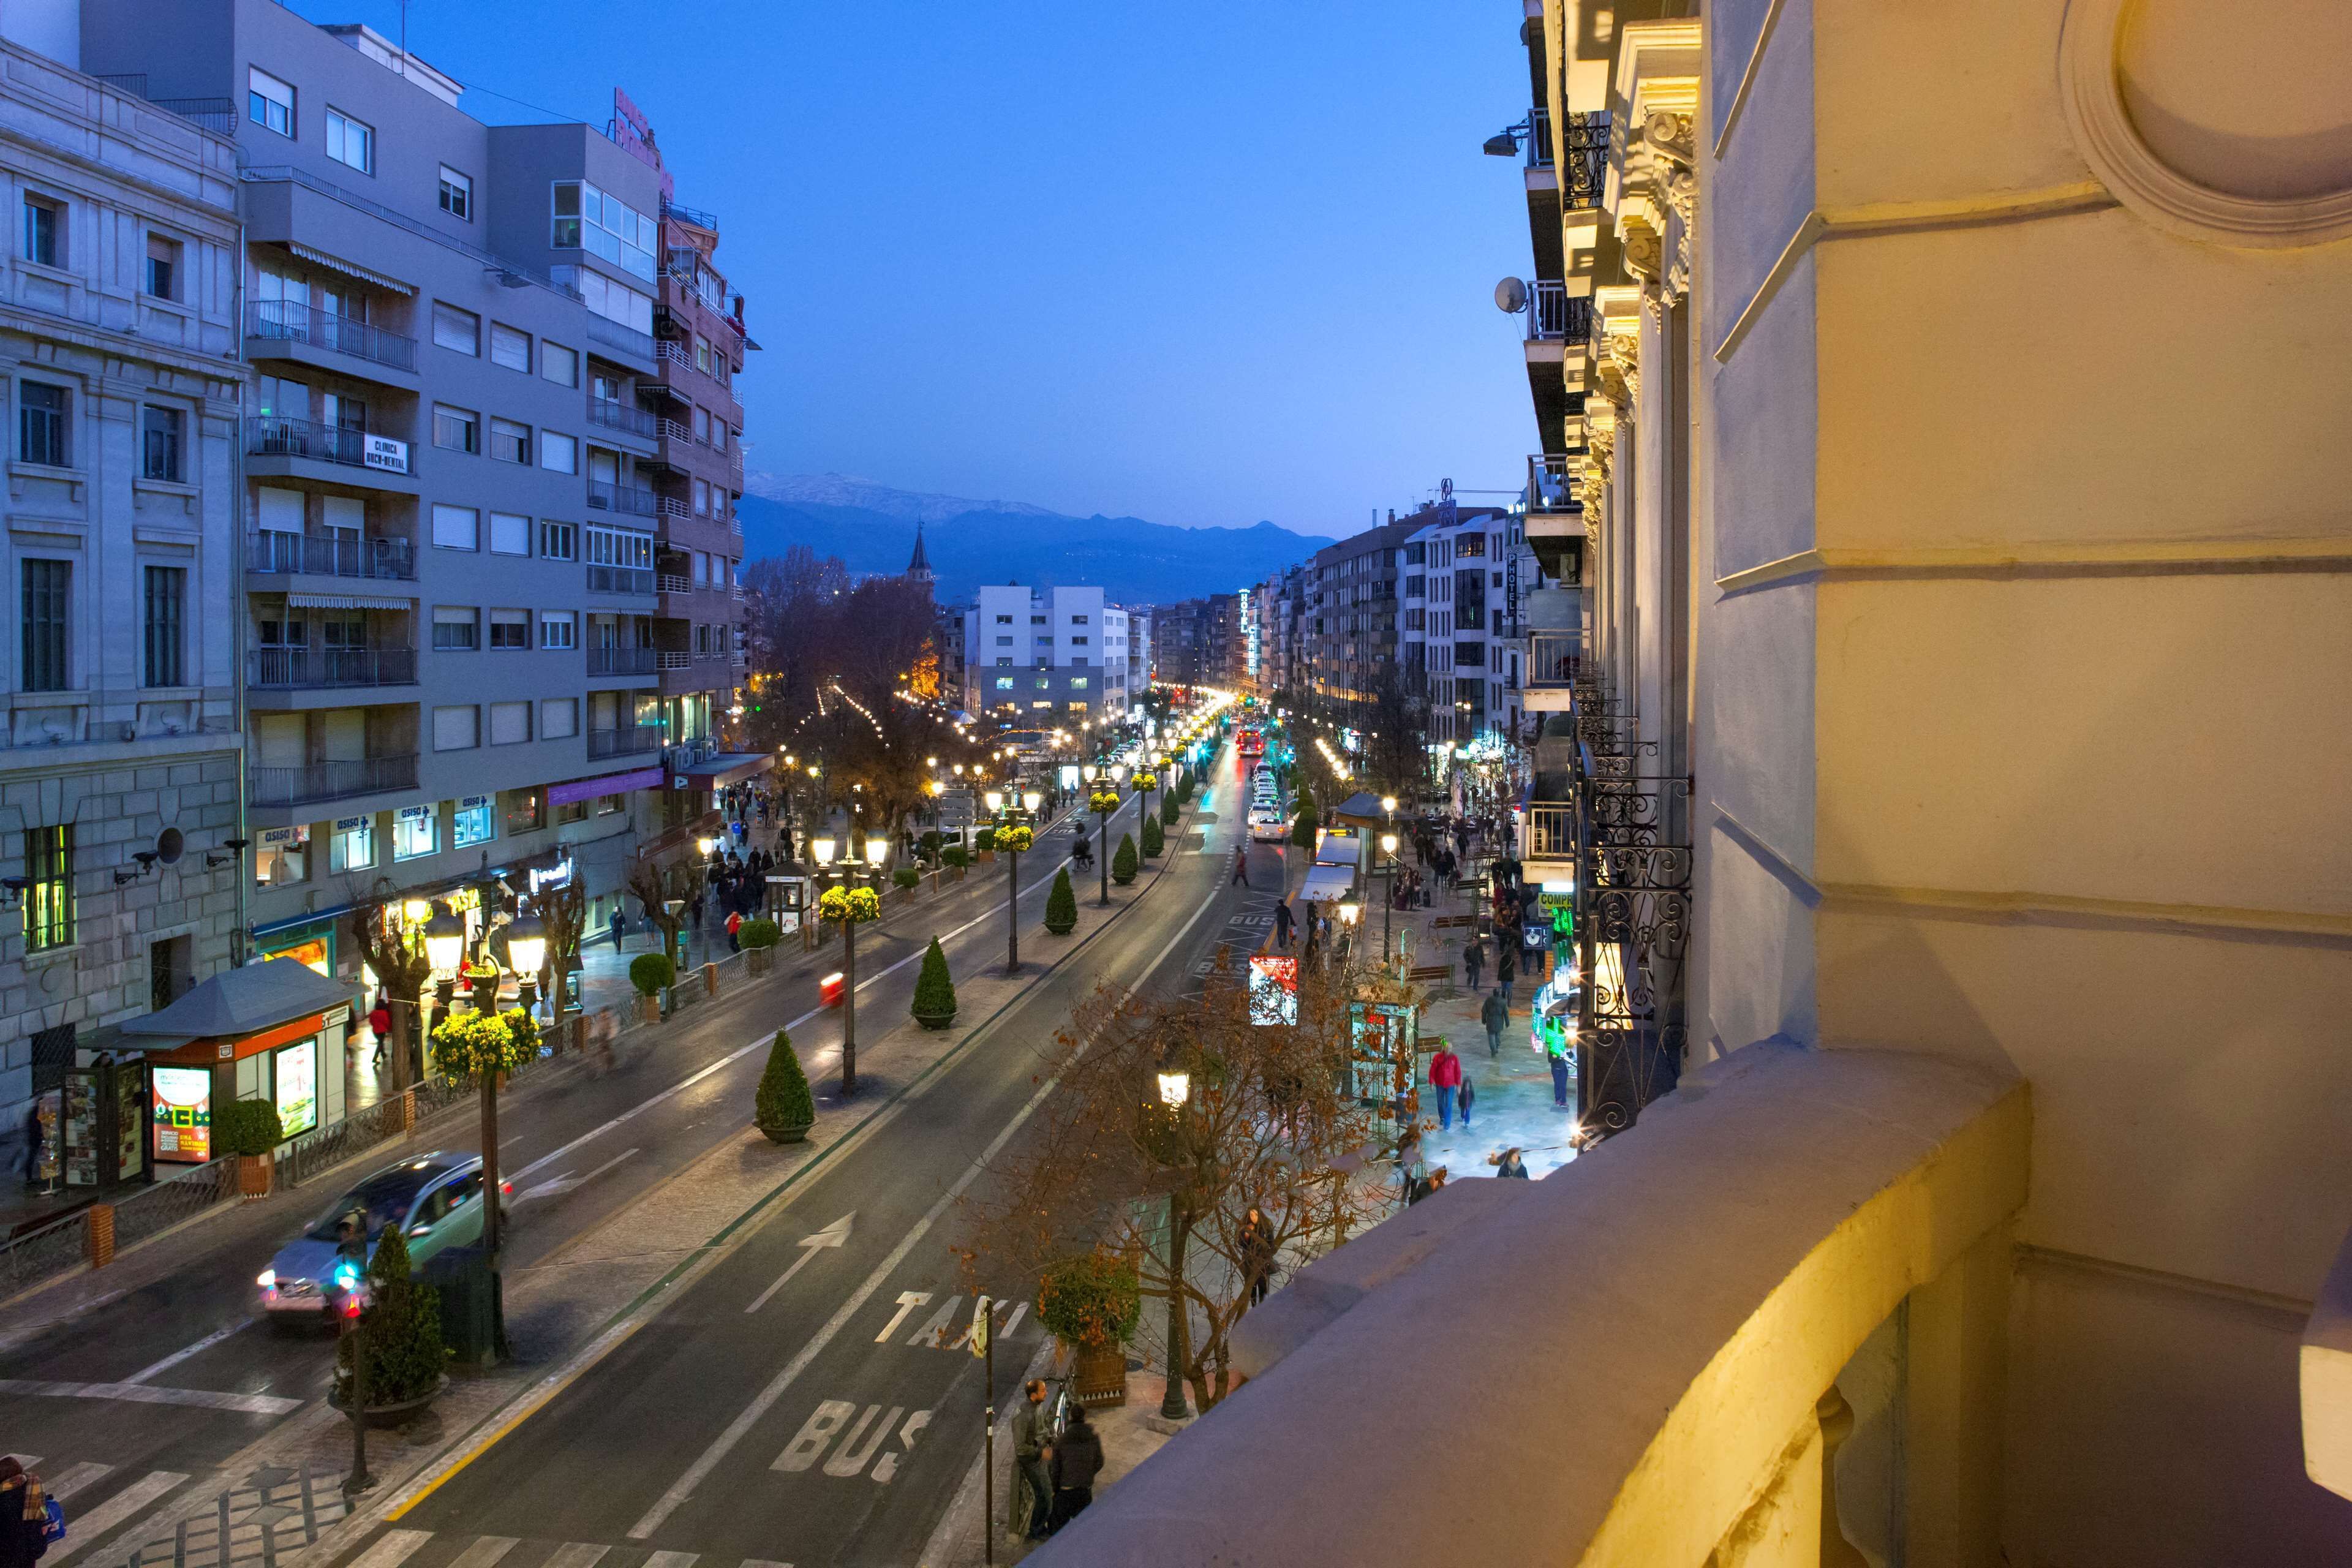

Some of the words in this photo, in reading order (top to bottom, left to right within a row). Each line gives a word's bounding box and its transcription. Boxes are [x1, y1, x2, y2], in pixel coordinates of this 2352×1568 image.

[375, 440, 398, 455] CLINICA
[463, 797, 480, 807] asisa
[402, 807, 421, 818] asisa
[337, 818, 359, 830] asisa
[265, 828, 290, 842] asisa
[1229, 916, 1275, 925] BUS
[769, 1400, 935, 1484] BUS
